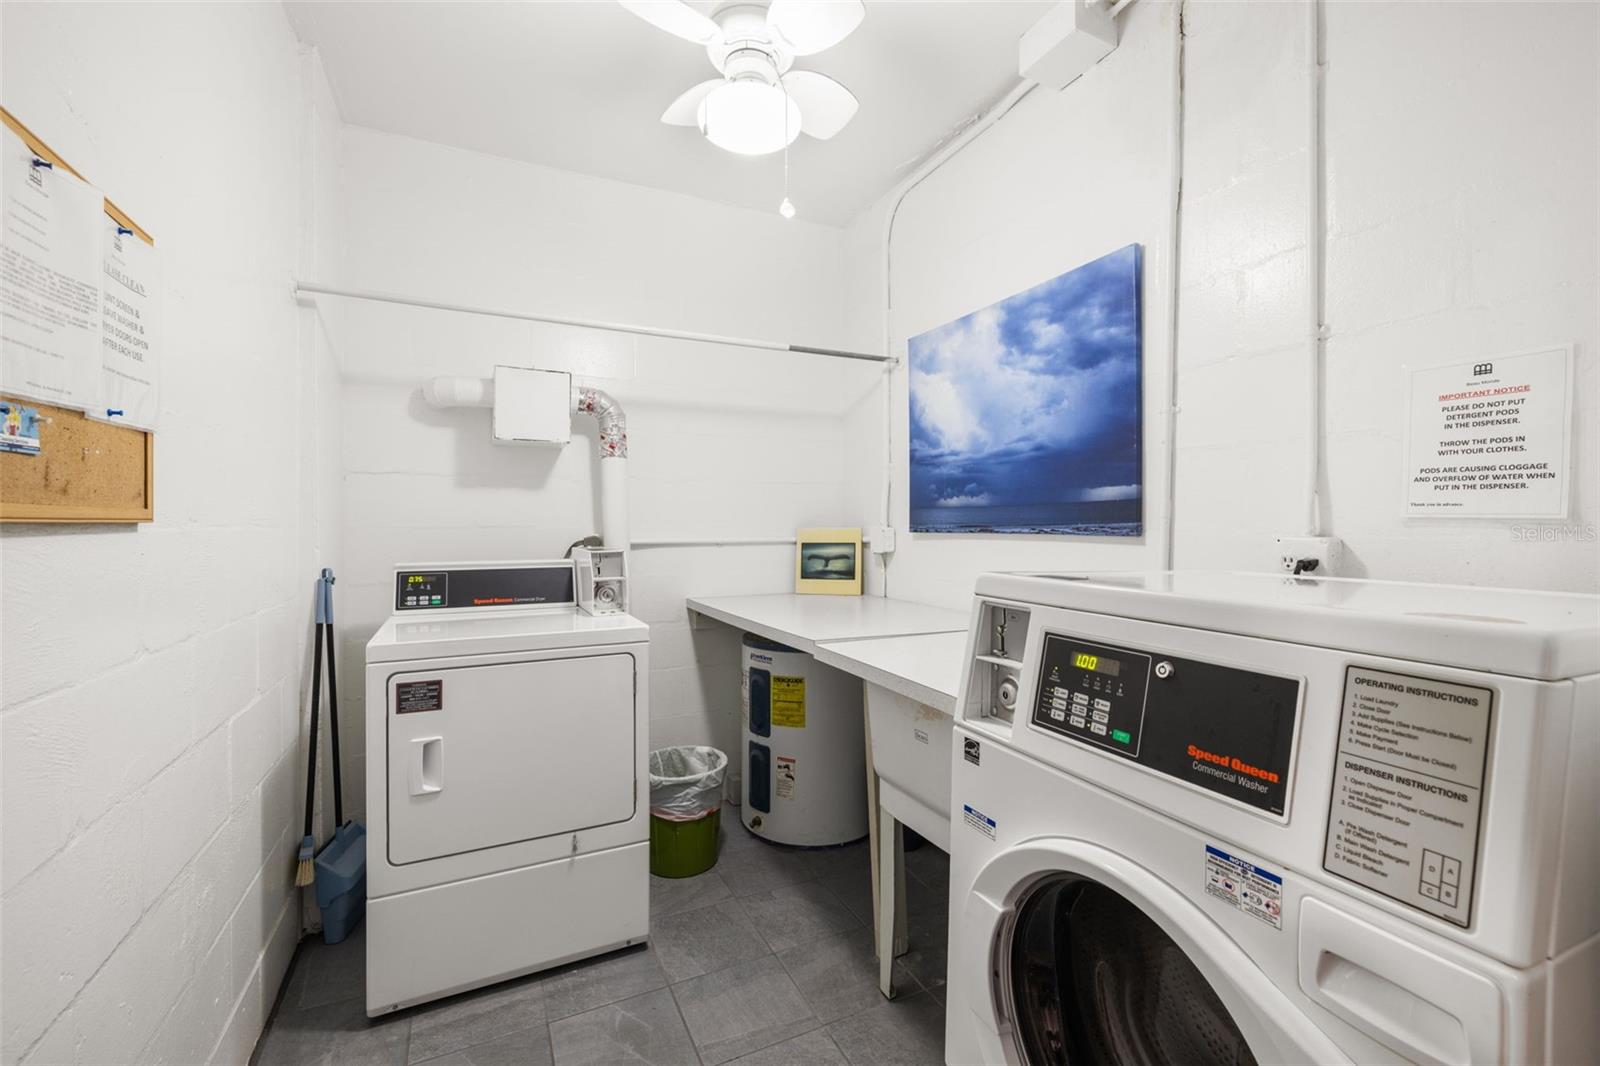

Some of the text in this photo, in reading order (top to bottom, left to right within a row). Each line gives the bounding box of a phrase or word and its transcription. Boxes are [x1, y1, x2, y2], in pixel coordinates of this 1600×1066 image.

[1438, 385, 1531, 401] IMPORTANT NOTICE
[1441, 398, 1526, 413] PLEASE DO NOT PUT
[1446, 408, 1520, 421] DETERGENT PODS
[1472, 417, 1521, 428] DISPENSER.
[1439, 439, 1470, 447] THROW
[1489, 436, 1514, 444] PODS
[1460, 447, 1484, 455] YOUR
[1485, 445, 1528, 454] CLOTHES.
[1459, 465, 1497, 473] CAUSING
[1498, 462, 1549, 471] CLOGGAGE
[1432, 474, 1477, 482] OVERFLOW
[1491, 473, 1524, 481] WATER
[1479, 482, 1529, 490] DISPENSER.
[1354, 677, 1479, 707] OPERATING INSTRUCTIONS
[1359, 704, 1375, 712] Close
[1376, 707, 1391, 715] Door
[1360, 695, 1374, 703] Load
[1376, 698, 1399, 708] Laundry
[1357, 722, 1372, 730] Make
[1373, 725, 1389, 734] Cycle
[1391, 729, 1419, 741] Selection
[1370, 715, 1395, 726] Supplies
[1396, 720, 1410, 729] (See
[1412, 724, 1448, 738] Instructions
[1449, 732, 1473, 744] Below)
[1356, 730, 1371, 739] Make
[1372, 734, 1399, 746] Payment
[1355, 739, 1371, 748] Press
[1372, 743, 1386, 752] Start
[1387, 747, 1404, 757] (Door
[1405, 752, 1420, 761] Must
[1431, 759, 1457, 771] Closed)
[1187, 744, 1280, 783] Speed Queen
[1192, 760, 1269, 793] Commercial Washer
[1344, 761, 1469, 803] DISPENSER INSTRUCTIONS
[1350, 777, 1366, 788] Open
[1367, 781, 1396, 796] Dispenser
[1397, 791, 1413, 801] Door
[1349, 788, 1363, 797] Load
[1364, 791, 1389, 805] Supplies
[1397, 801, 1418, 814] Proper
[1419, 809, 1464, 828] Compartment
[1356, 796, 1383, 809] Indicated
[1347, 801, 1364, 811] Close
[1364, 806, 1394, 822] Dispenser
[1395, 817, 1410, 827] Door
[1346, 822, 1357, 830] Pre
[1358, 825, 1375, 836] Wash
[1377, 830, 1408, 848] Detergent
[1343, 847, 1361, 858] Liquid
[1362, 853, 1384, 866] Bleach
[1344, 837, 1359, 847] Main
[1360, 842, 1377, 854] Wash
[1378, 848, 1410, 866] Detergent
[1229, 856, 1255, 872] NOTICE
[1342, 855, 1361, 867] Fabric
[1362, 861, 1388, 878] Softener
[1428, 865, 1436, 873] D
[1426, 887, 1433, 895] C
